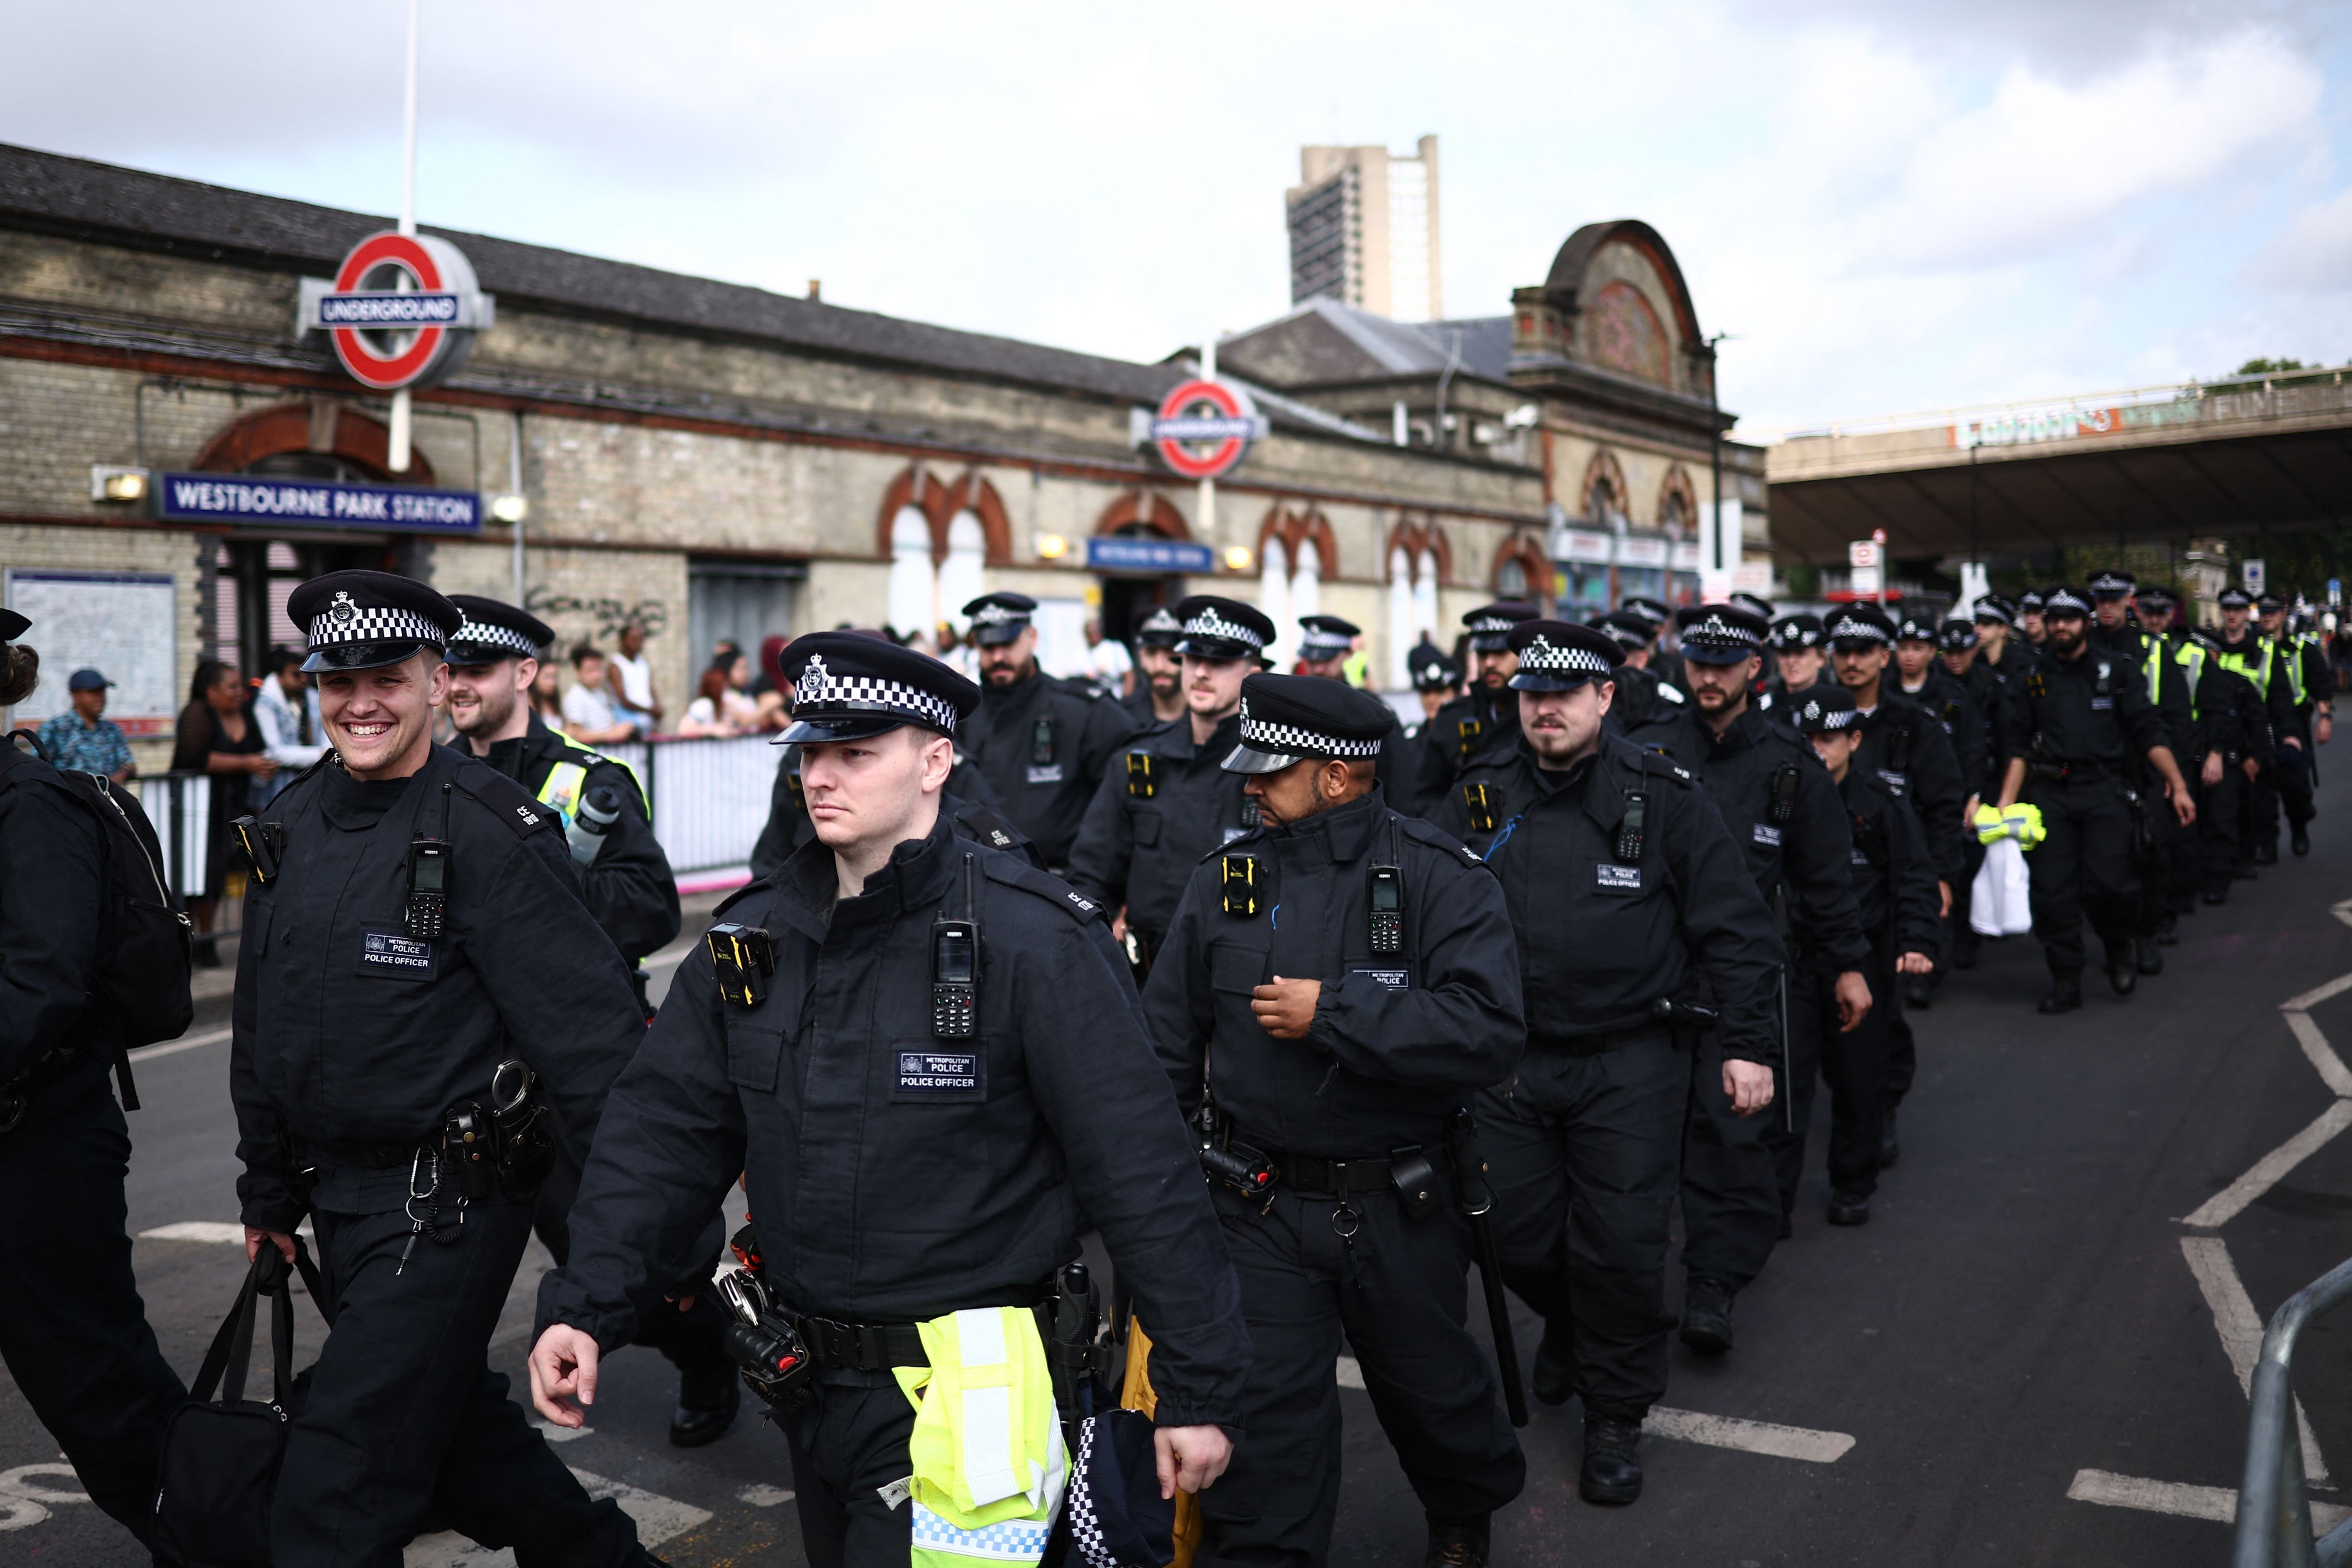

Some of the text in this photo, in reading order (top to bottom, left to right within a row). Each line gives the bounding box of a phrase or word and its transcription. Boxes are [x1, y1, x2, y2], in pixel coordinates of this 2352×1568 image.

[324, 297, 456, 321] UNDERGROUND
[176, 481, 473, 524] WESTBOURNE PARK STATION
[517, 805, 530, 816] CE
[523, 814, 539, 825] 1910
[991, 830, 1003, 838] CE
[994, 837, 1010, 845] 1762
[389, 939, 426, 947] METROPOLITAN
[393, 945, 420, 954] POLICE
[365, 954, 428, 967] POLICE OFFICER
[931, 1064, 963, 1072] POLICE
[901, 1078, 974, 1086] POLICE OFFICER
